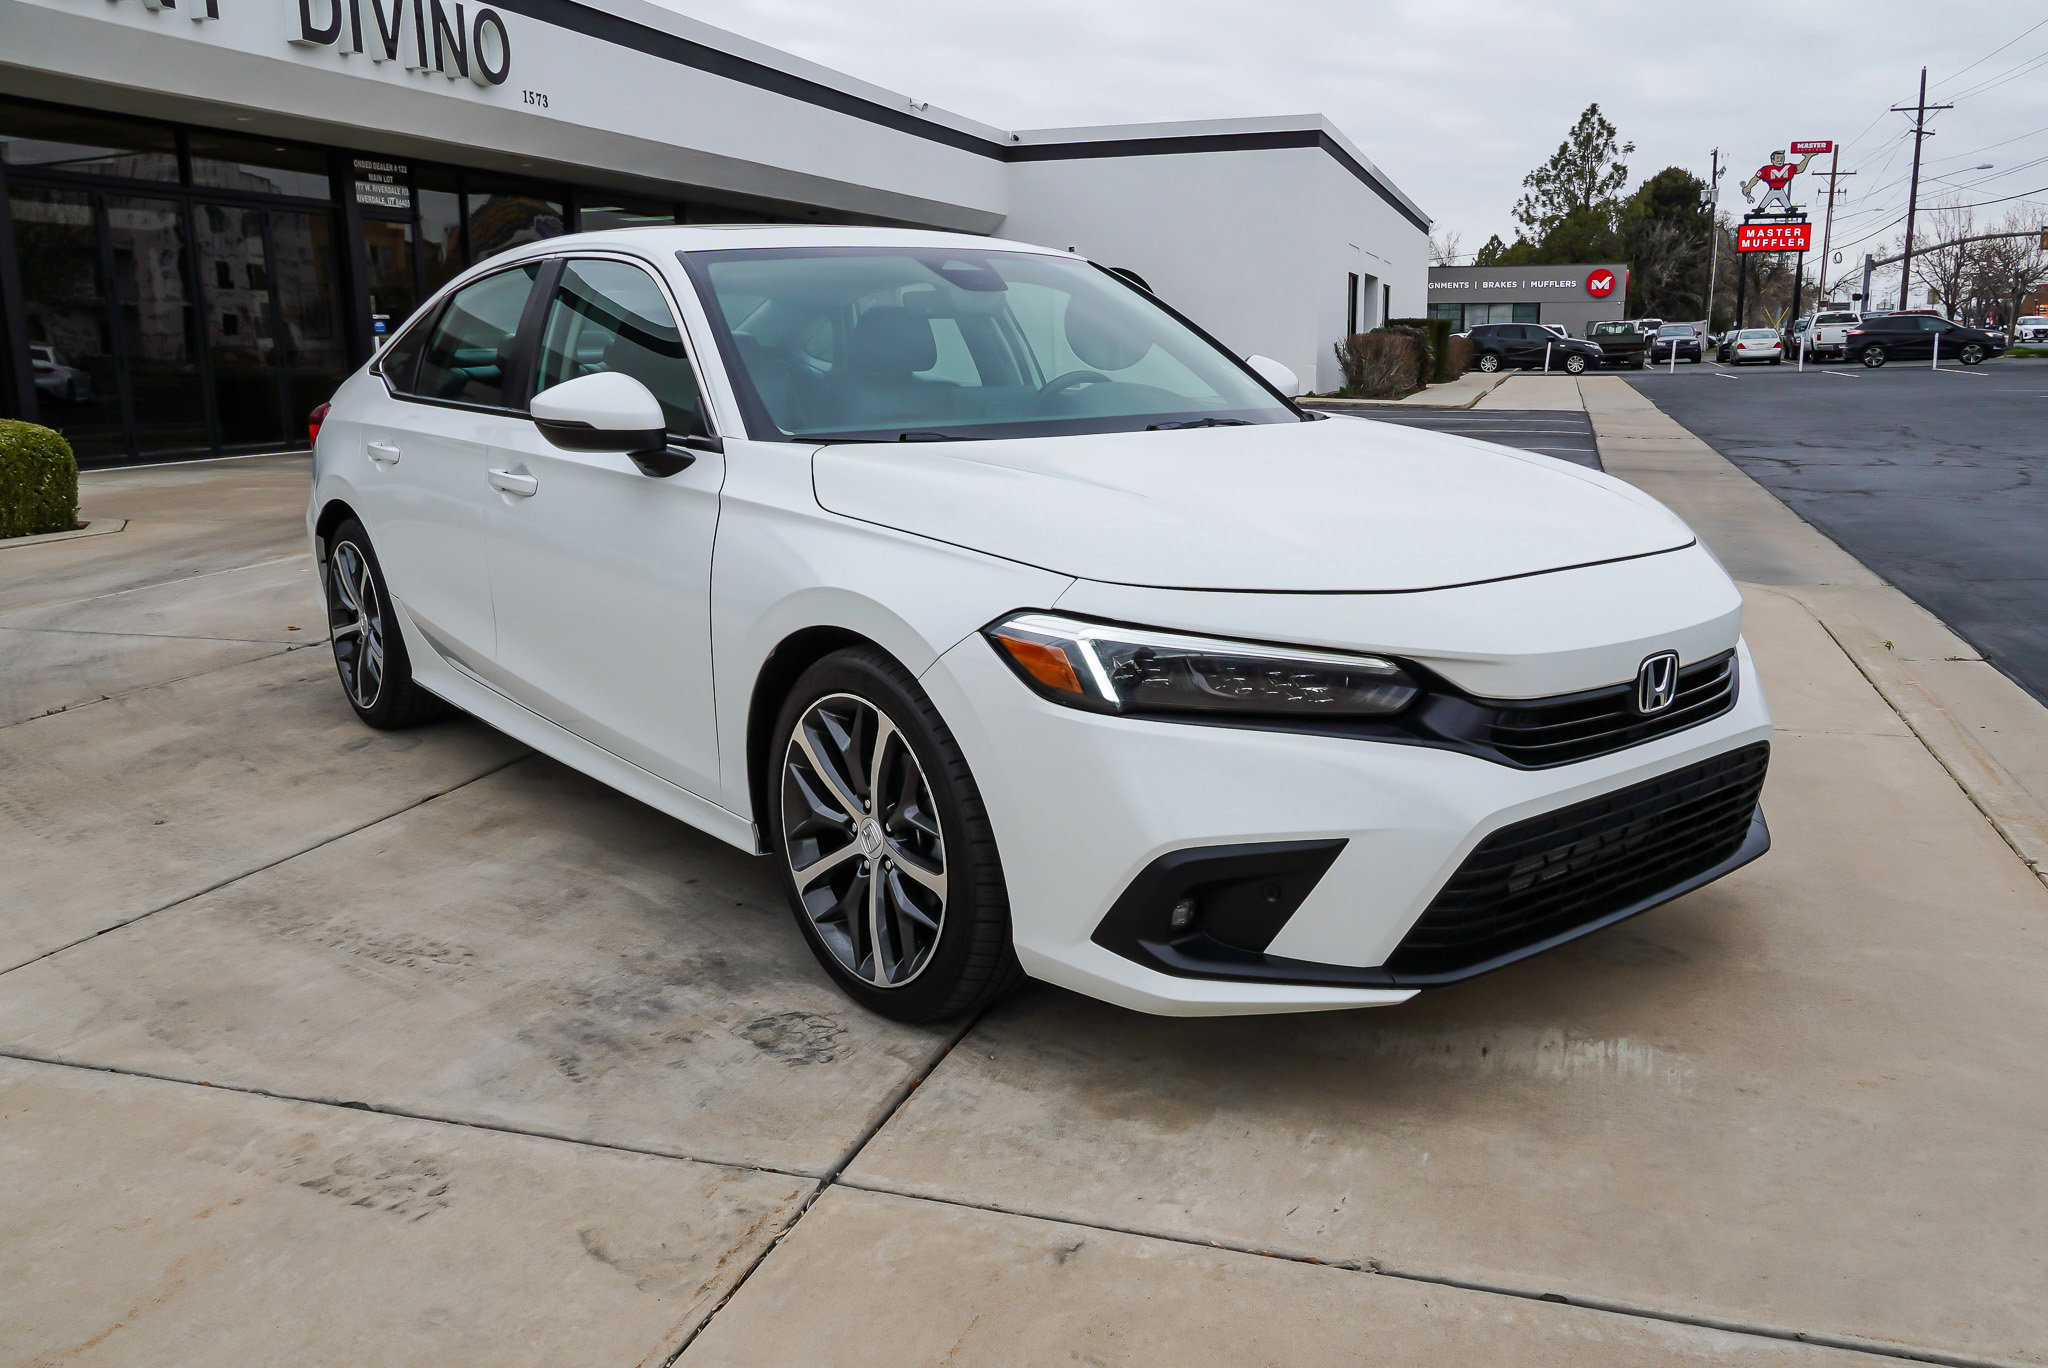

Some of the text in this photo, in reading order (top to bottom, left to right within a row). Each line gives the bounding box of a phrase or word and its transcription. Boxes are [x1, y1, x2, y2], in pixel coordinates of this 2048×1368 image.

[296, 0, 511, 86] DIVINO
[522, 89, 549, 109] 1573
[368, 173, 394, 184] MAIN LOT
[1746, 228, 1802, 238] MASTER
[1741, 238, 1805, 248] MUFFLER
[1428, 280, 1577, 289] GNMENTS BRAKES MUFFLERS
